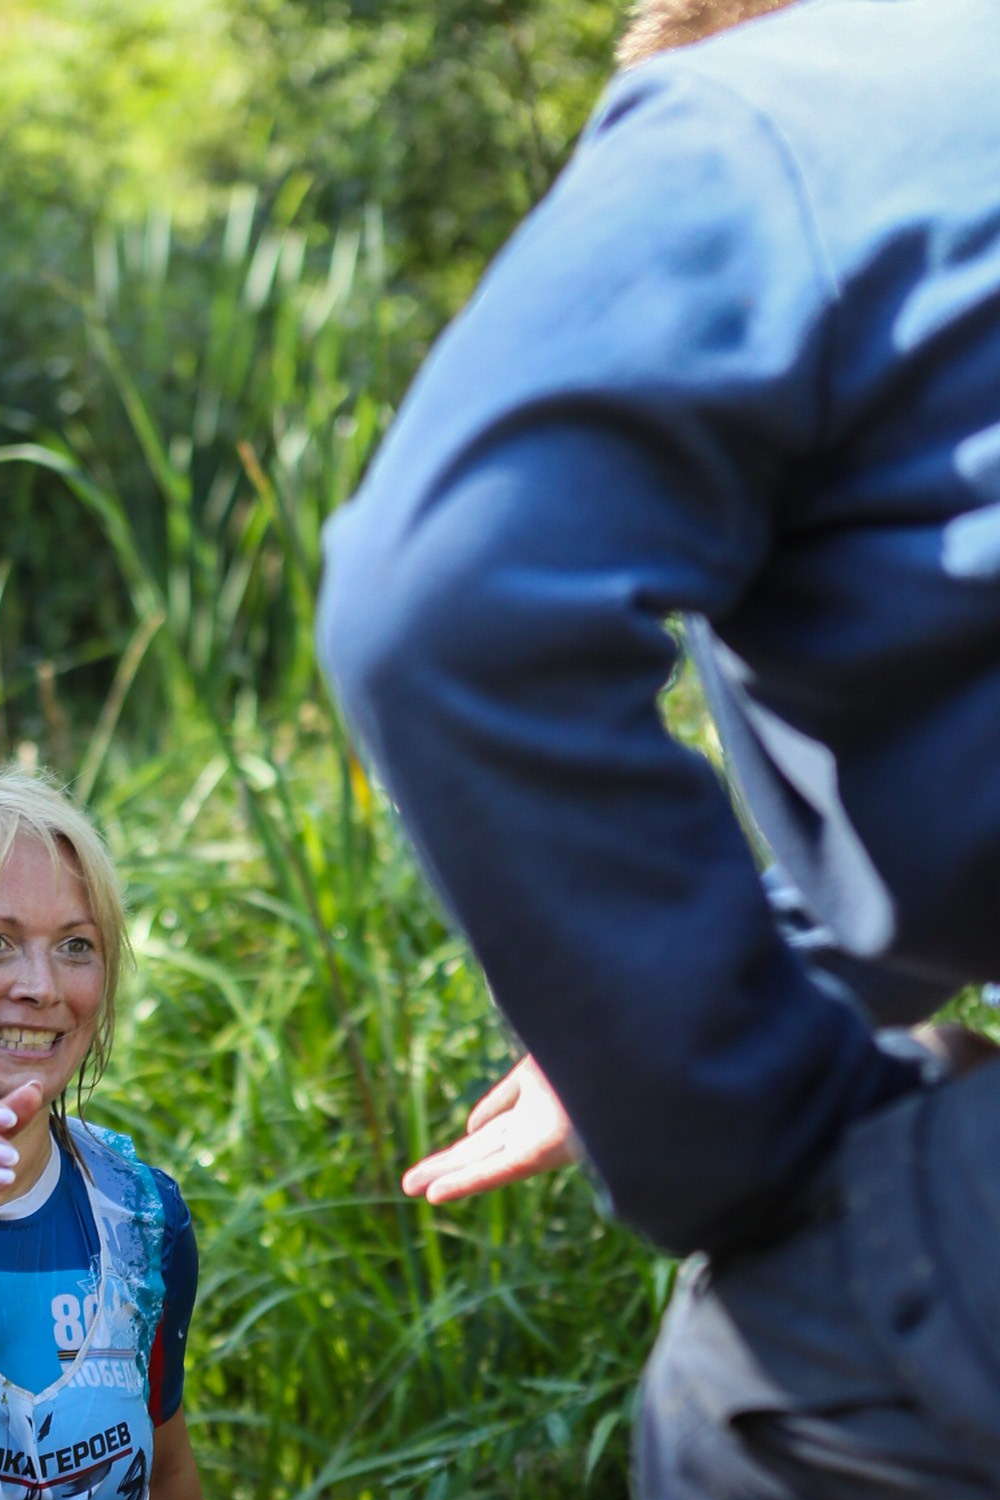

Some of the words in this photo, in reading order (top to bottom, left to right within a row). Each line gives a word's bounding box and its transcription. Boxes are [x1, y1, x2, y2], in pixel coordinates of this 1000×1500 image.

[51, 1293, 111, 1351] 80
[60, 1360, 143, 1392] ПОБЕД
[38, 1421, 132, 1479] ГЕРОЕВ
